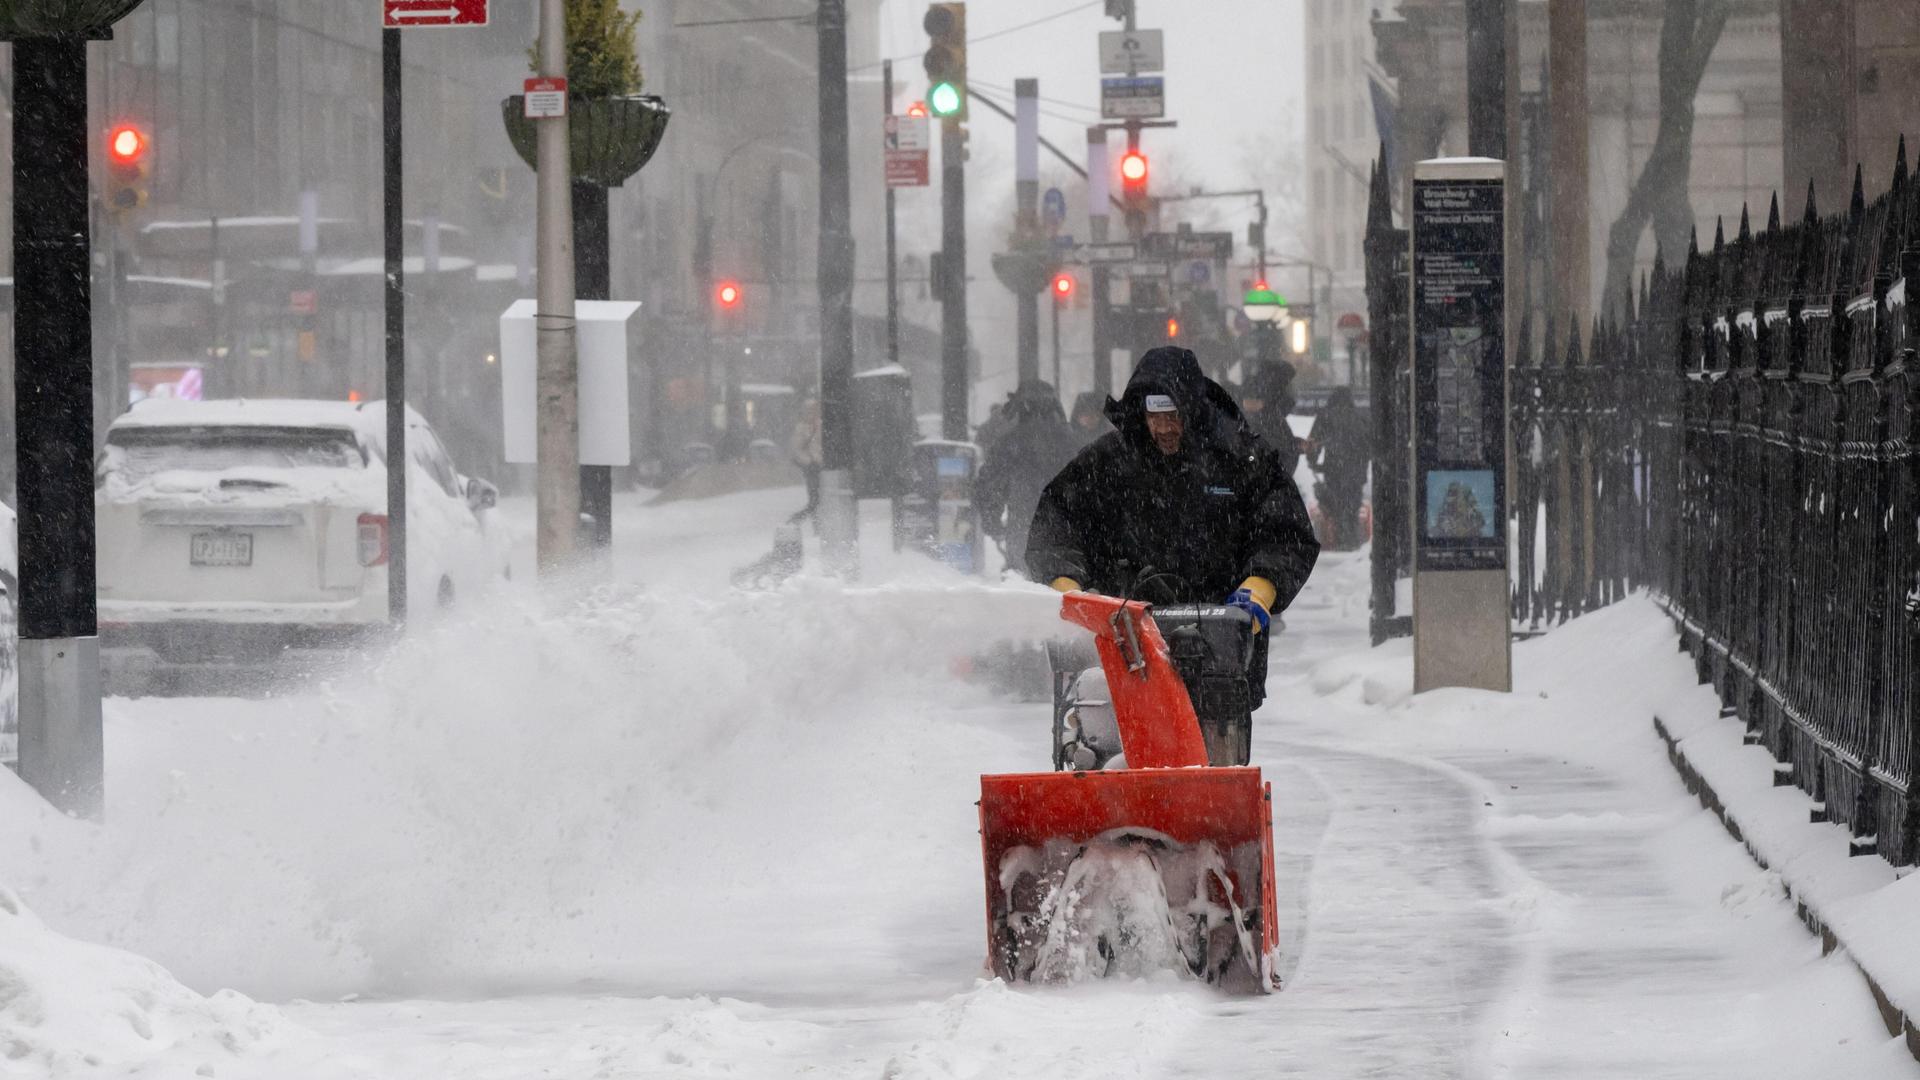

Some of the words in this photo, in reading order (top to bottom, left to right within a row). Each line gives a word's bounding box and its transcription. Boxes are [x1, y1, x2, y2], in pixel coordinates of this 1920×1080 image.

[1424, 189, 1467, 199] Broadway
[1424, 200, 1442, 208] Wall
[1443, 199, 1469, 208] Street
[1424, 215, 1461, 223] Financial
[1463, 215, 1494, 223] District
[1151, 608, 1211, 616] rofessional
[1212, 608, 1226, 616] 28
